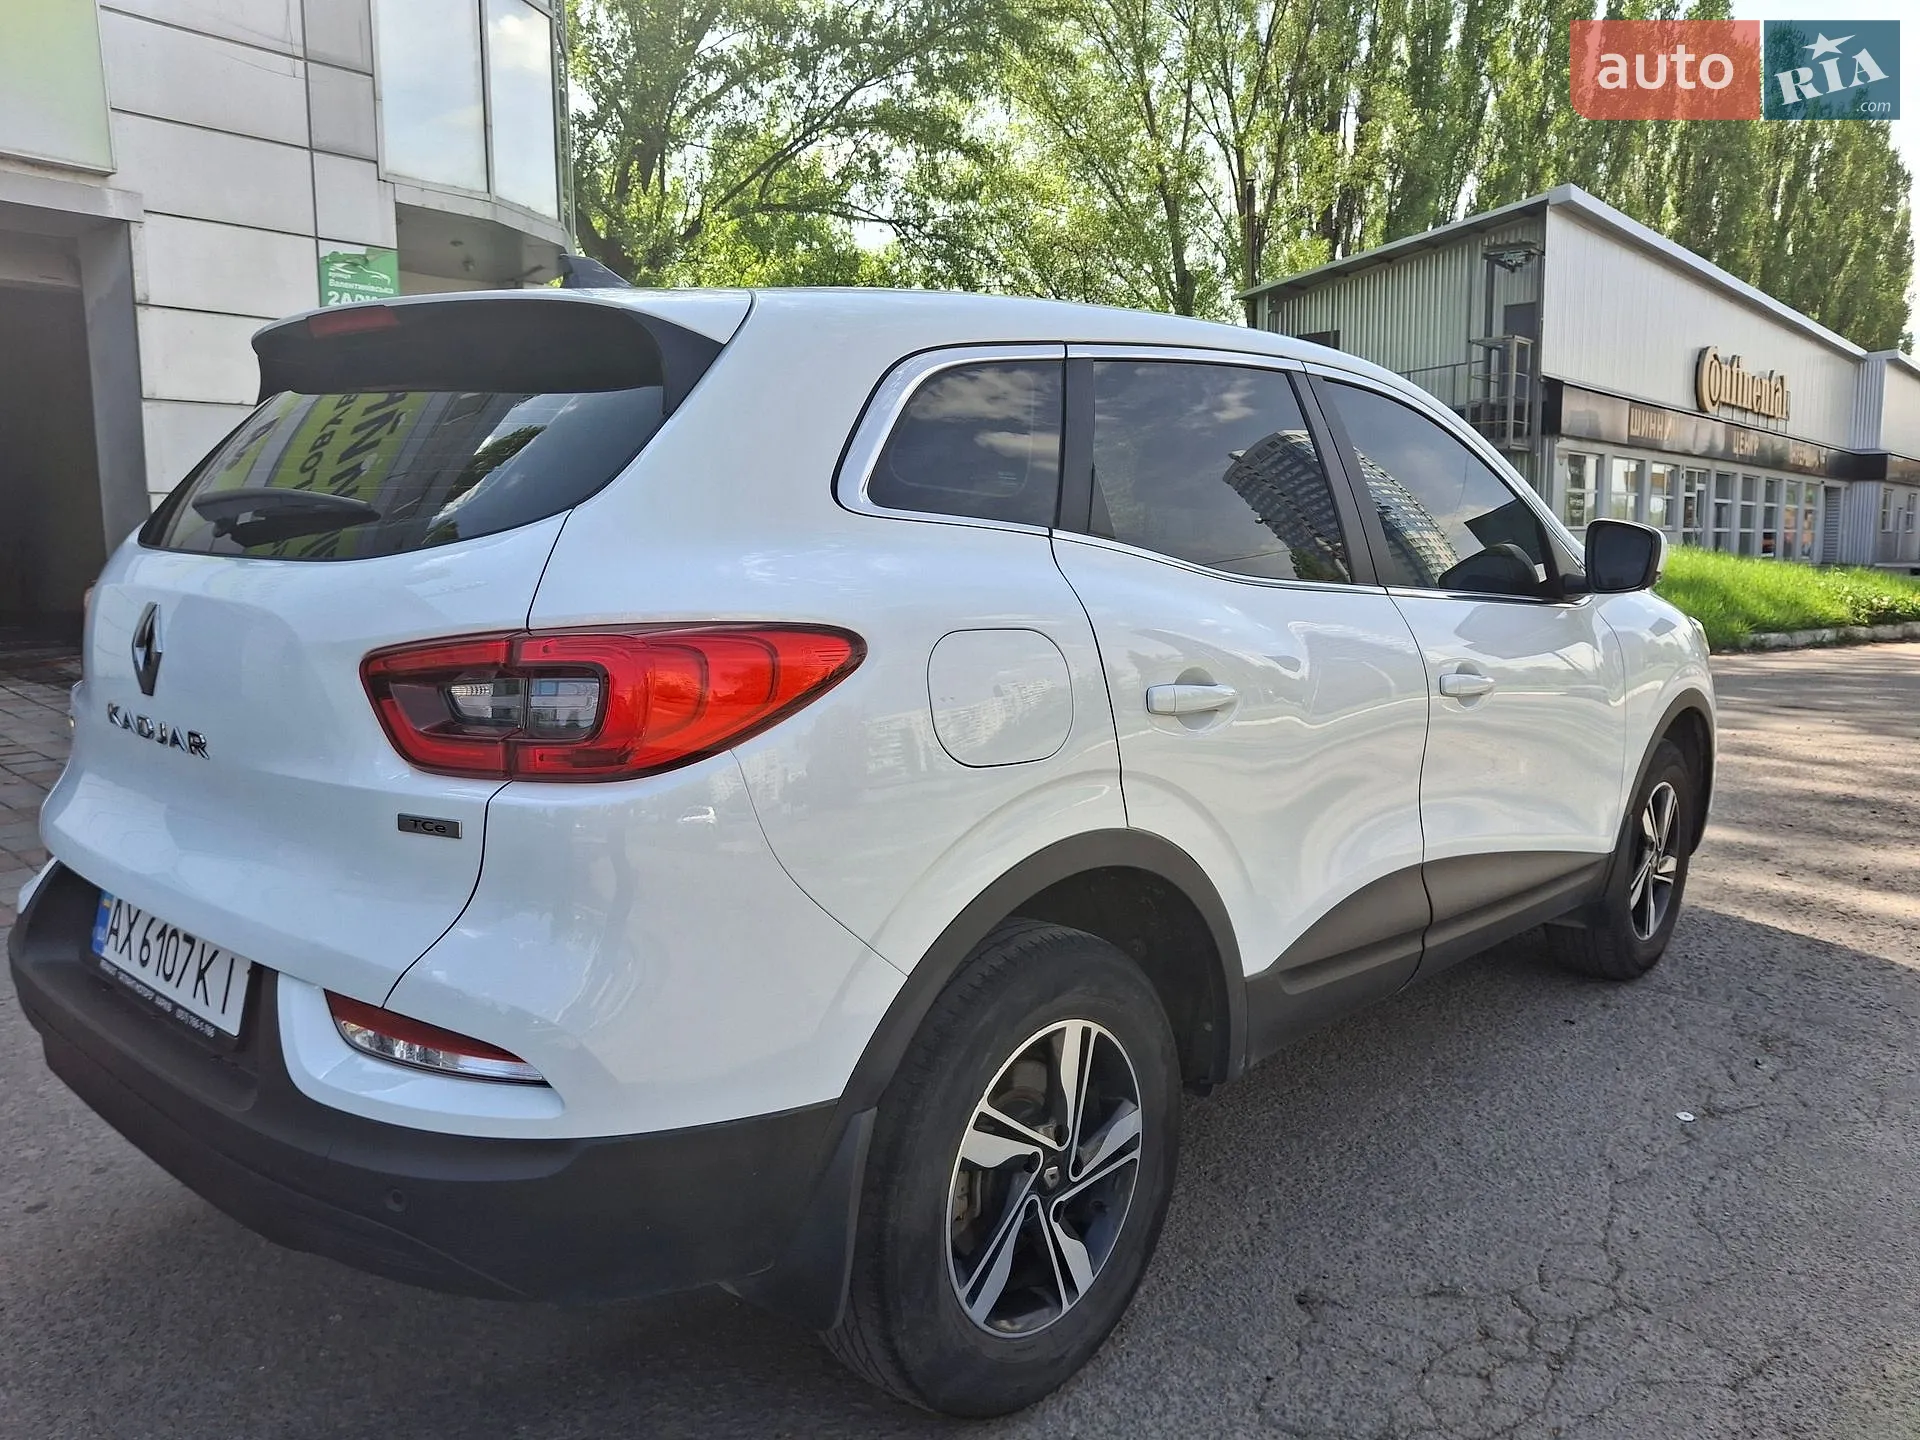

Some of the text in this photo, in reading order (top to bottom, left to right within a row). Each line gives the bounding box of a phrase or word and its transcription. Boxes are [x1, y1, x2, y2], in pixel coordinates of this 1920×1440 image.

[1696, 346, 1788, 420] Continental
[107, 703, 210, 760] KADJAR
[408, 819, 446, 833] TCe
